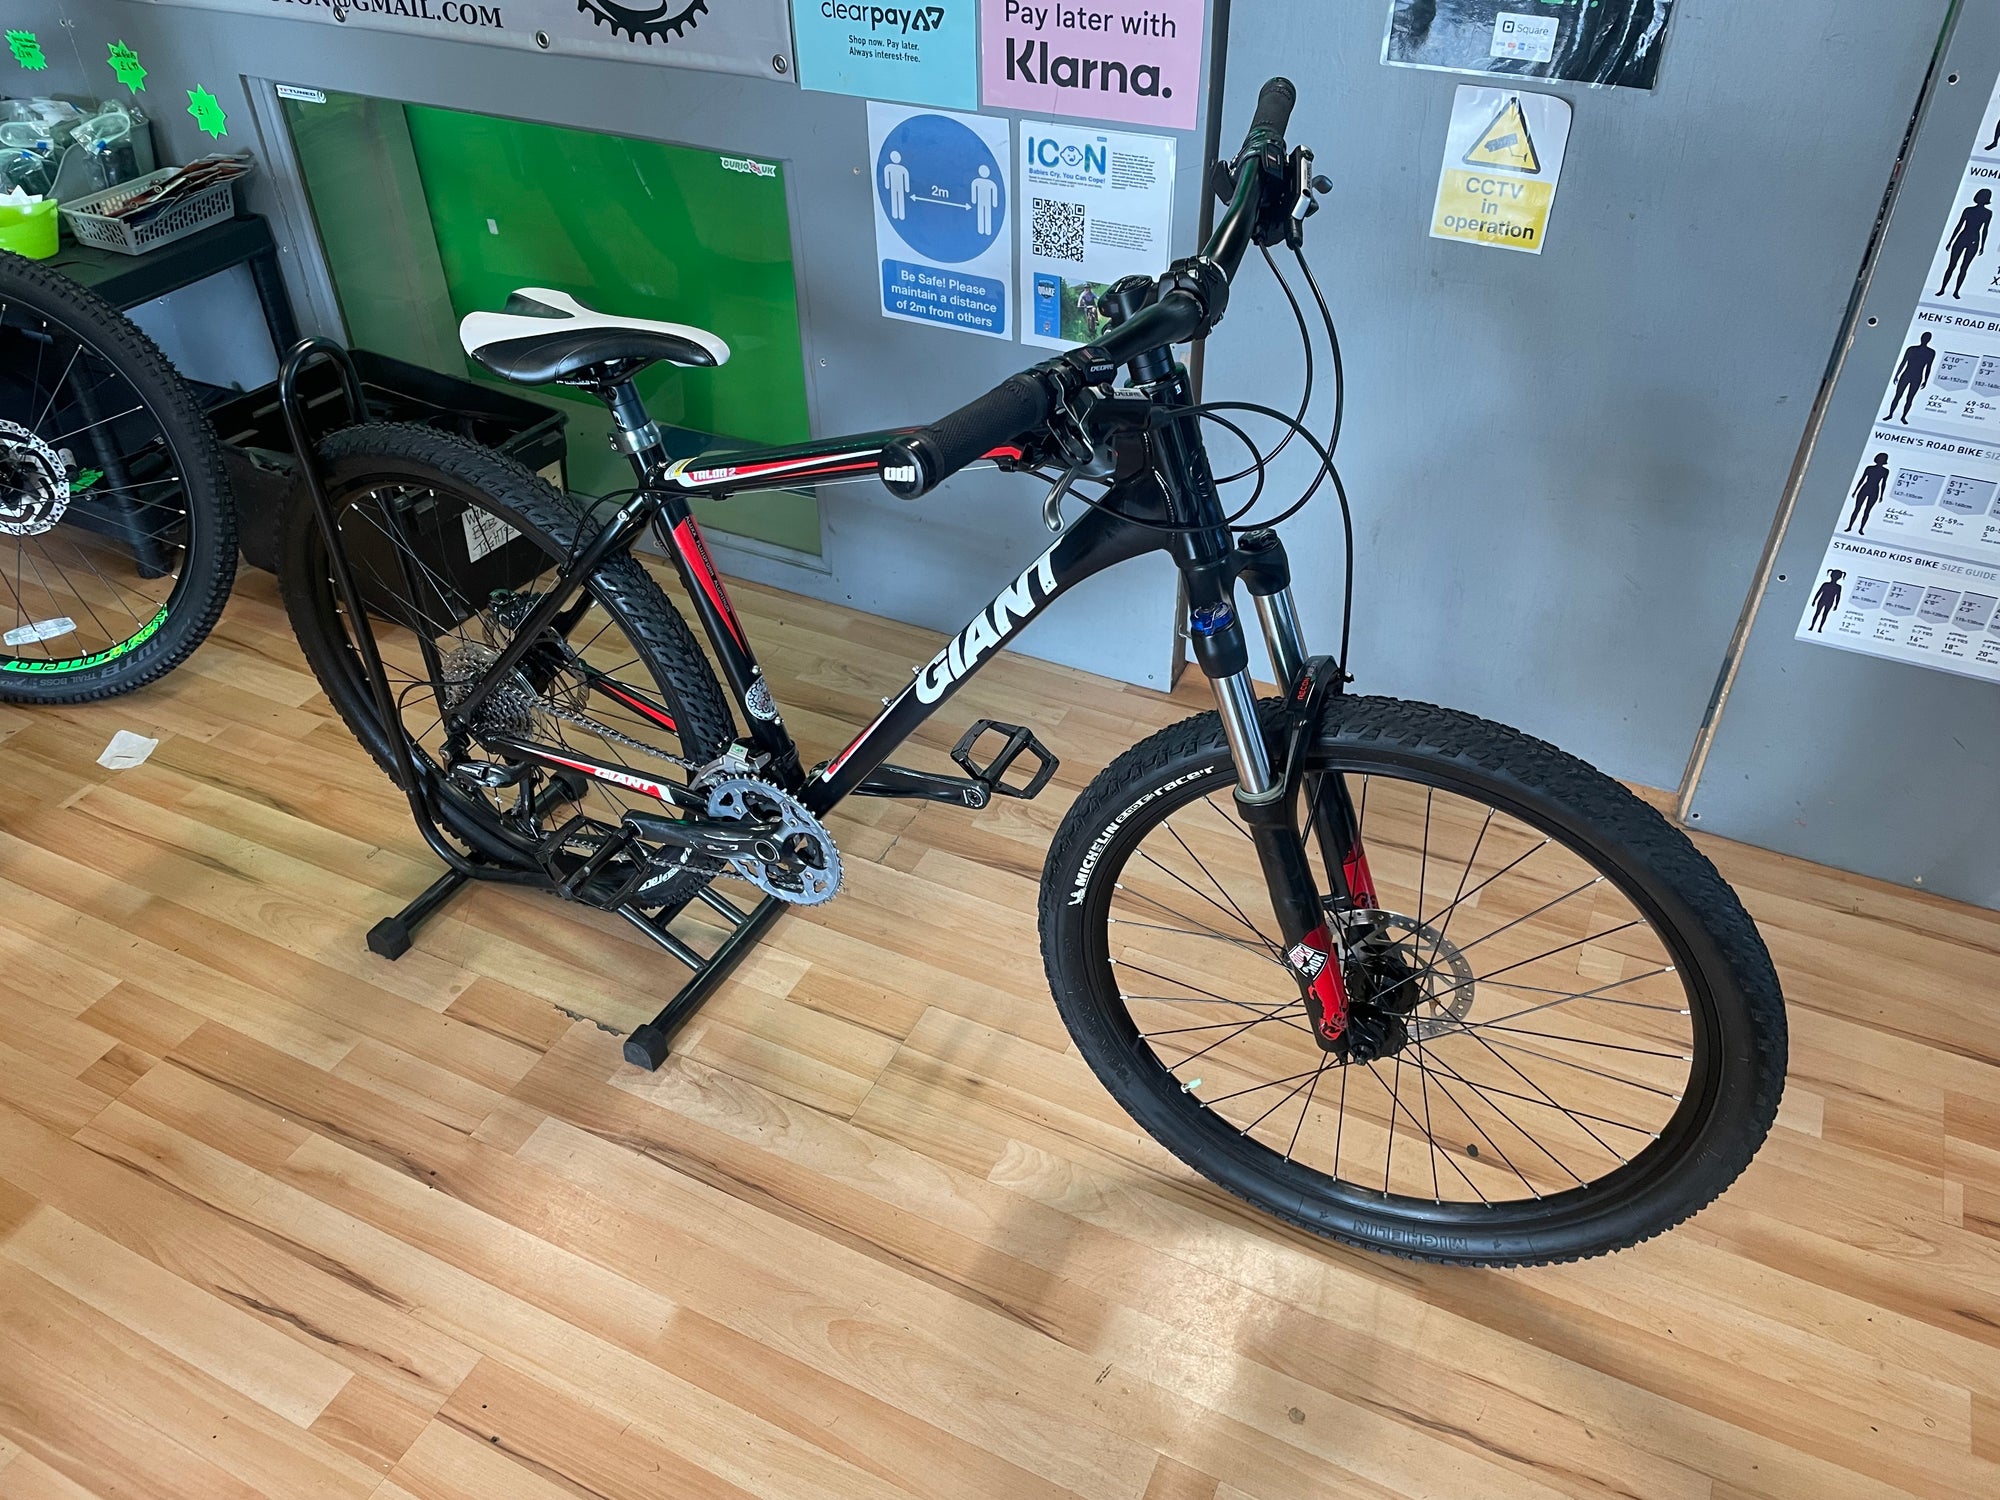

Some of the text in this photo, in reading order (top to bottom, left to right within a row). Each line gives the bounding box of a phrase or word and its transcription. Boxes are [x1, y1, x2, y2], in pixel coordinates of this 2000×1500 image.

[820, 0, 914, 34] clearpay
[1005, 0, 1177, 38] Pay later with
[1516, 23, 1549, 36] Square
[848, 34, 920, 52] Shop now. Pay later.
[849, 47, 921, 63] Always interest-free.
[1005, 37, 1173, 99] Klarna.
[1970, 167, 2000, 180] WOM
[931, 185, 950, 199] 2m
[1465, 177, 1524, 201] CCTV
[1480, 198, 1499, 216] in
[1443, 214, 1535, 241] operation
[901, 270, 986, 297] Be Safe! Please
[890, 283, 997, 314] maintain a distance
[896, 299, 993, 328] of 2m from others
[1918, 312, 2000, 332] MEN'S ROAD BI
[1874, 431, 1924, 447] WOMEN'S
[1926, 440, 1955, 452] ROAD
[1957, 446, 1984, 457] BIKE
[1833, 541, 1997, 581] STANDARD KIDS BIKE SIZE GUIDE
[915, 534, 1066, 704] GIANT
[100, 641, 160, 679] WTB
[594, 769, 652, 791] GIANT
[1074, 821, 1121, 887] MICHELIN
[1353, 1219, 1469, 1250] MICHELIN
